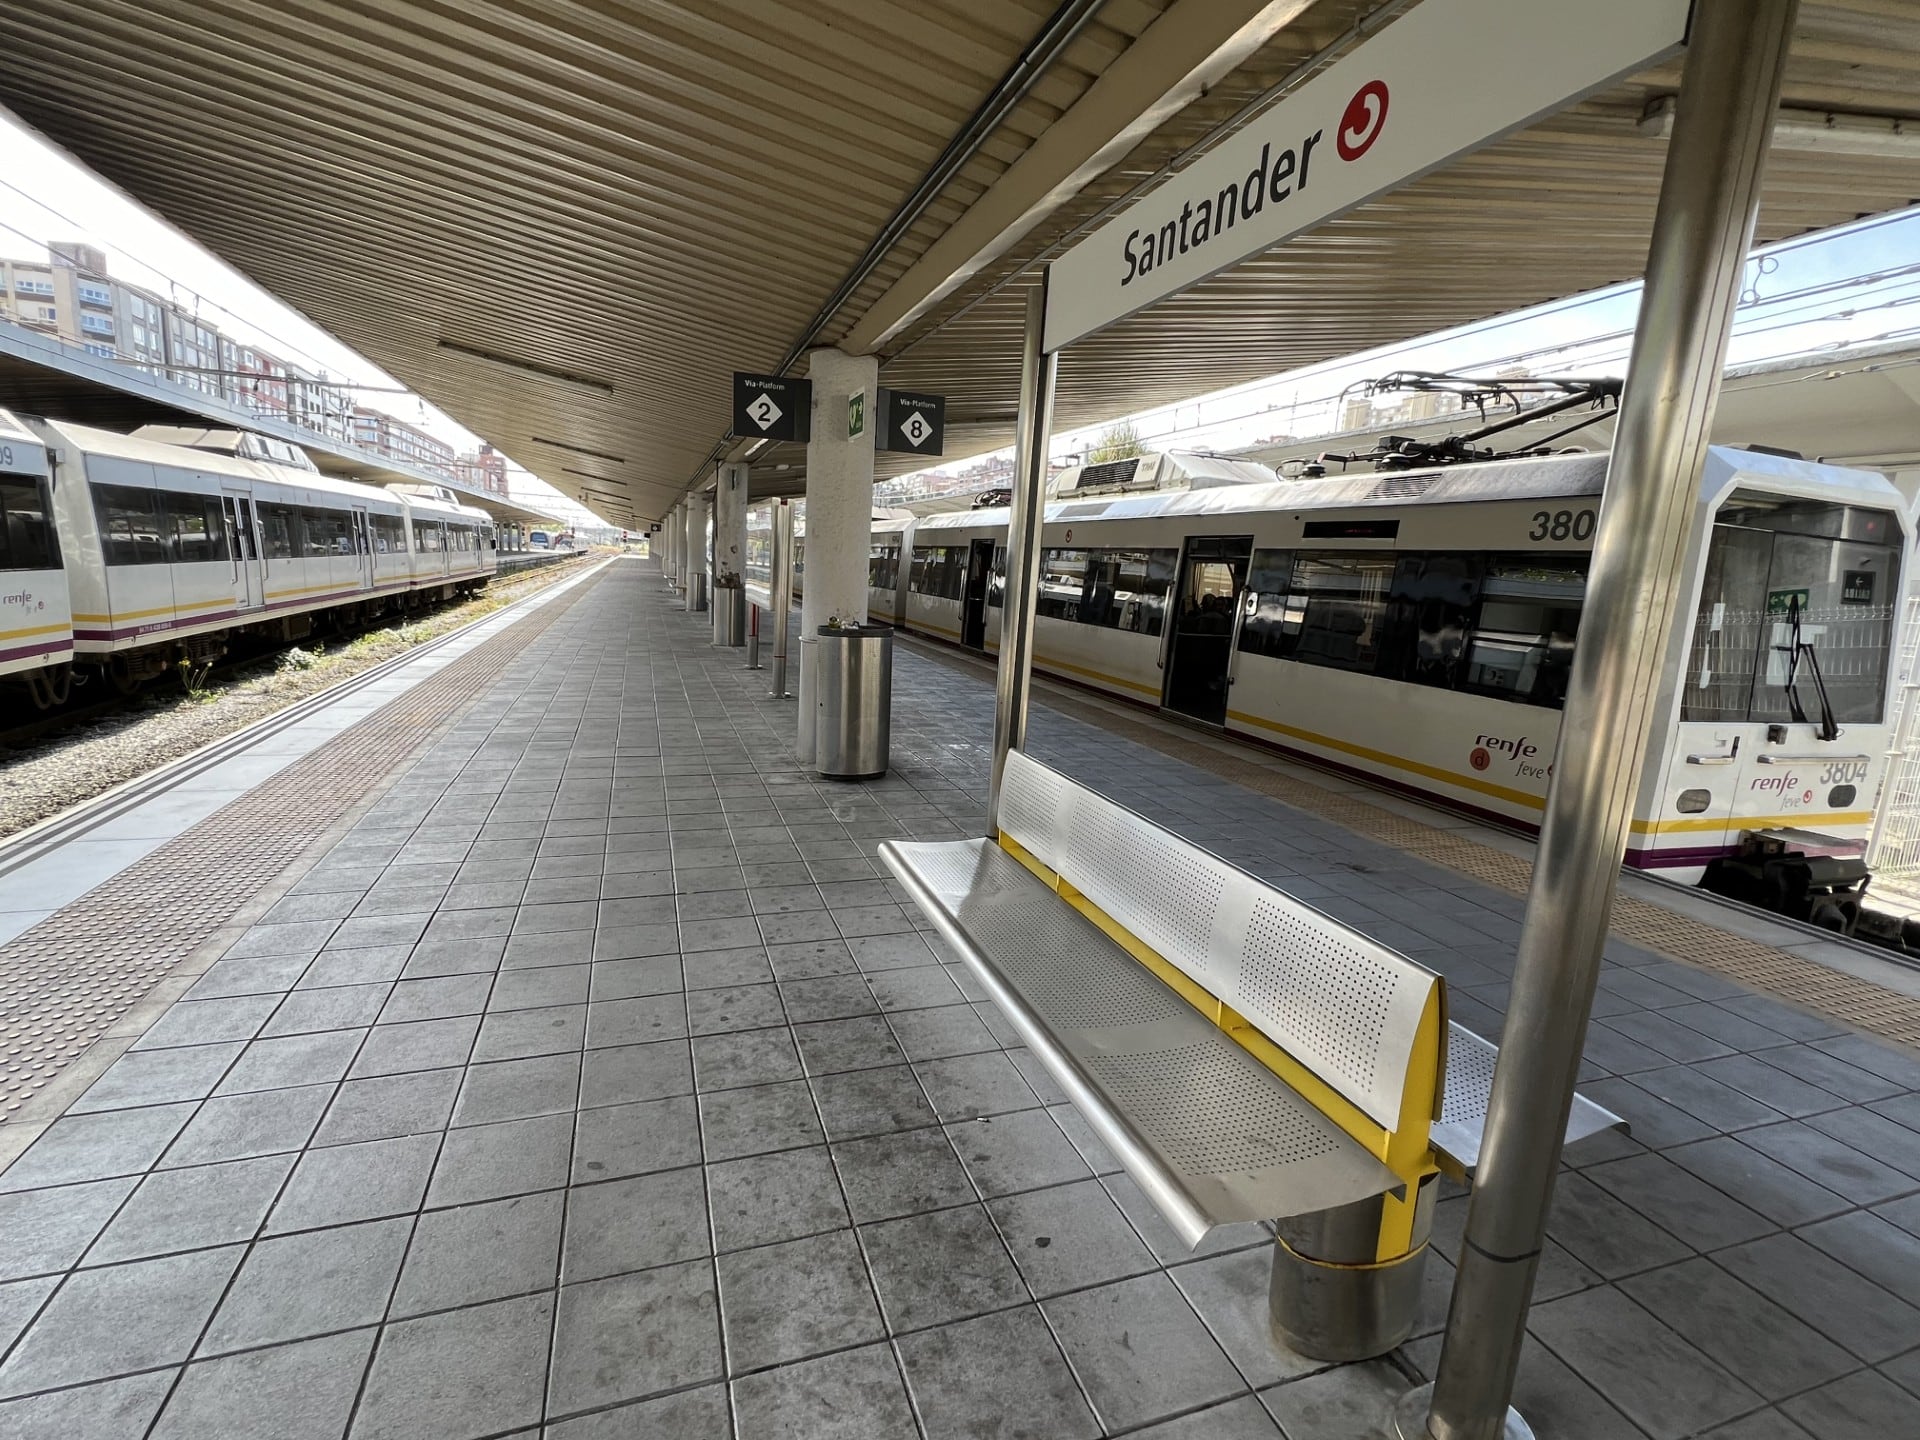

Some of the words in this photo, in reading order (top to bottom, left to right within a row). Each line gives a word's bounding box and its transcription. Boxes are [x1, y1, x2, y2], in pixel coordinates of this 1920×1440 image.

[1121, 128, 1323, 286] Santander
[757, 402, 771, 422] 2
[910, 420, 923, 438] 8
[1529, 509, 1599, 541] 380
[3, 589, 32, 607] renfe
[1475, 734, 1538, 761] renfe
[1515, 760, 1544, 779] feve
[1820, 762, 1868, 784] 3804
[1751, 770, 1798, 797] renfe
[1780, 794, 1801, 811] feve
